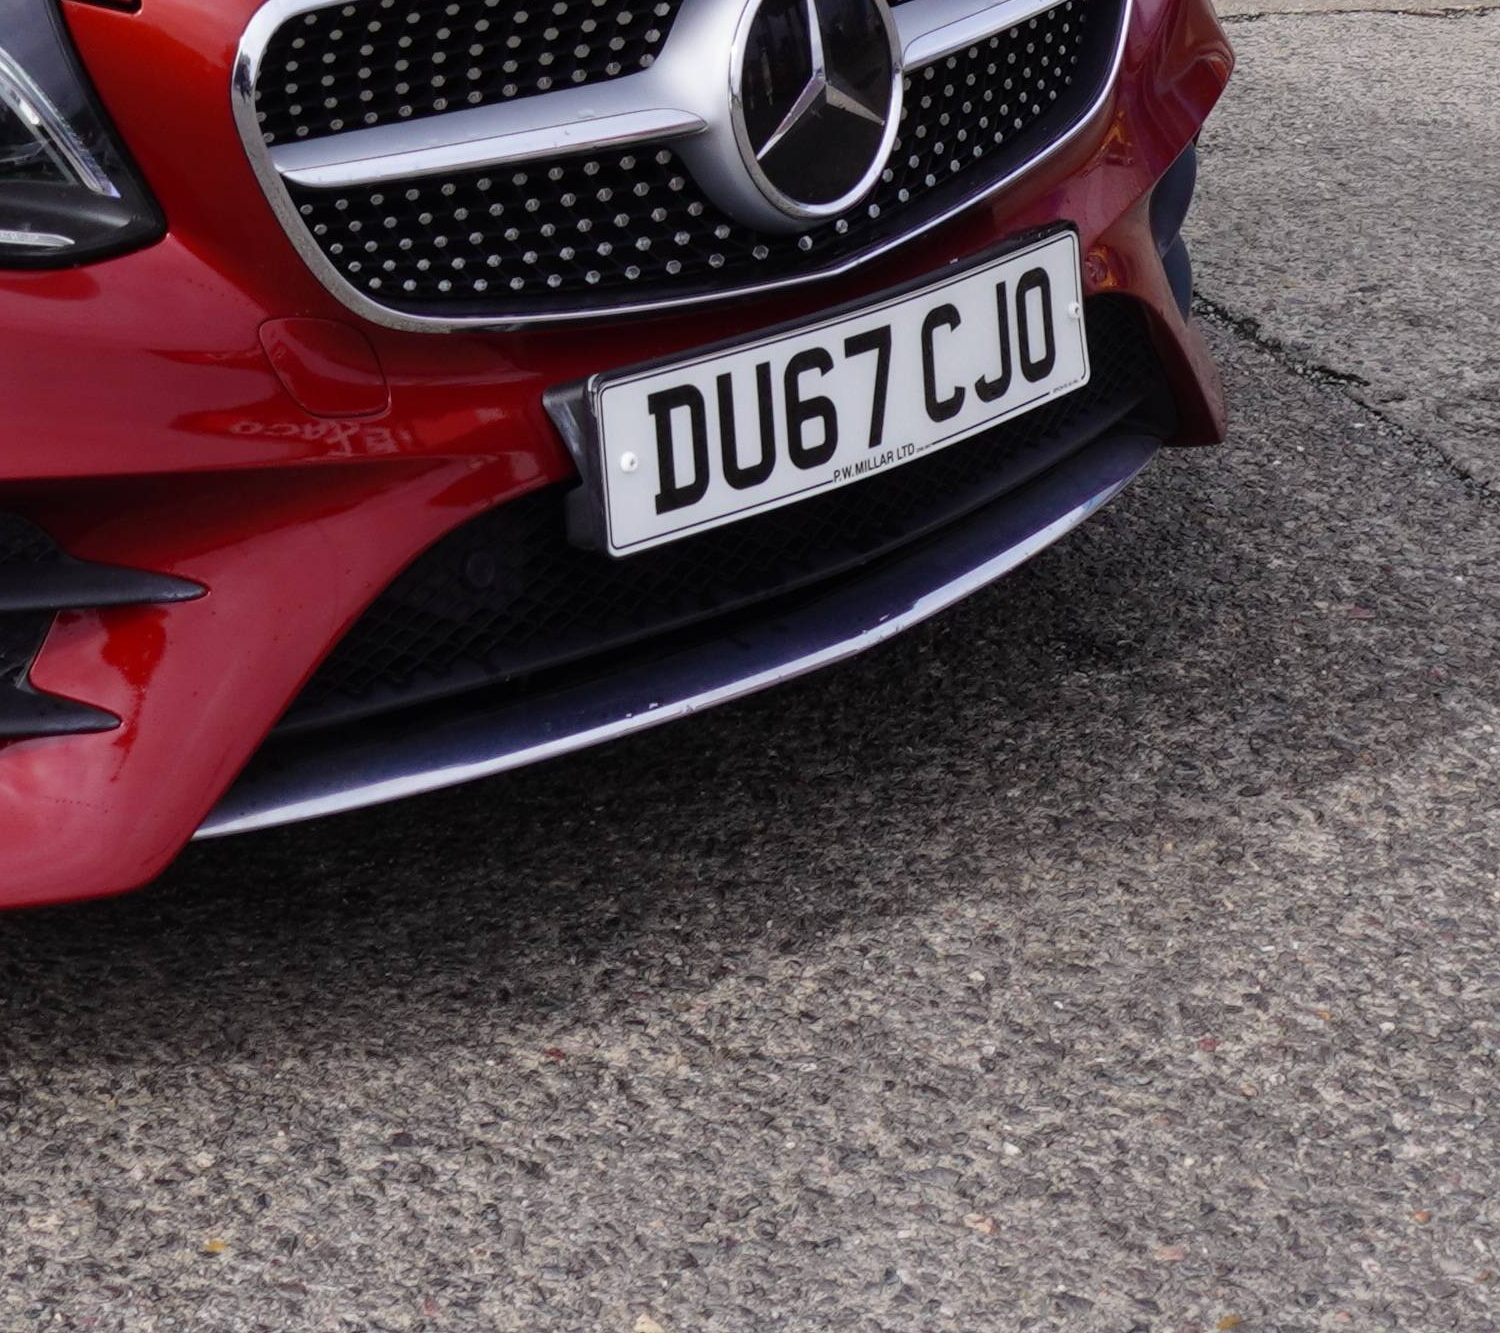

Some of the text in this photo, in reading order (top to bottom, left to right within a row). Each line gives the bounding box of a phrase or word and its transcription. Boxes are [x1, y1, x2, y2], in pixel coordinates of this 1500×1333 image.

[647, 266, 1056, 515] DU67 CJO
[896, 442, 915, 461] LTD
